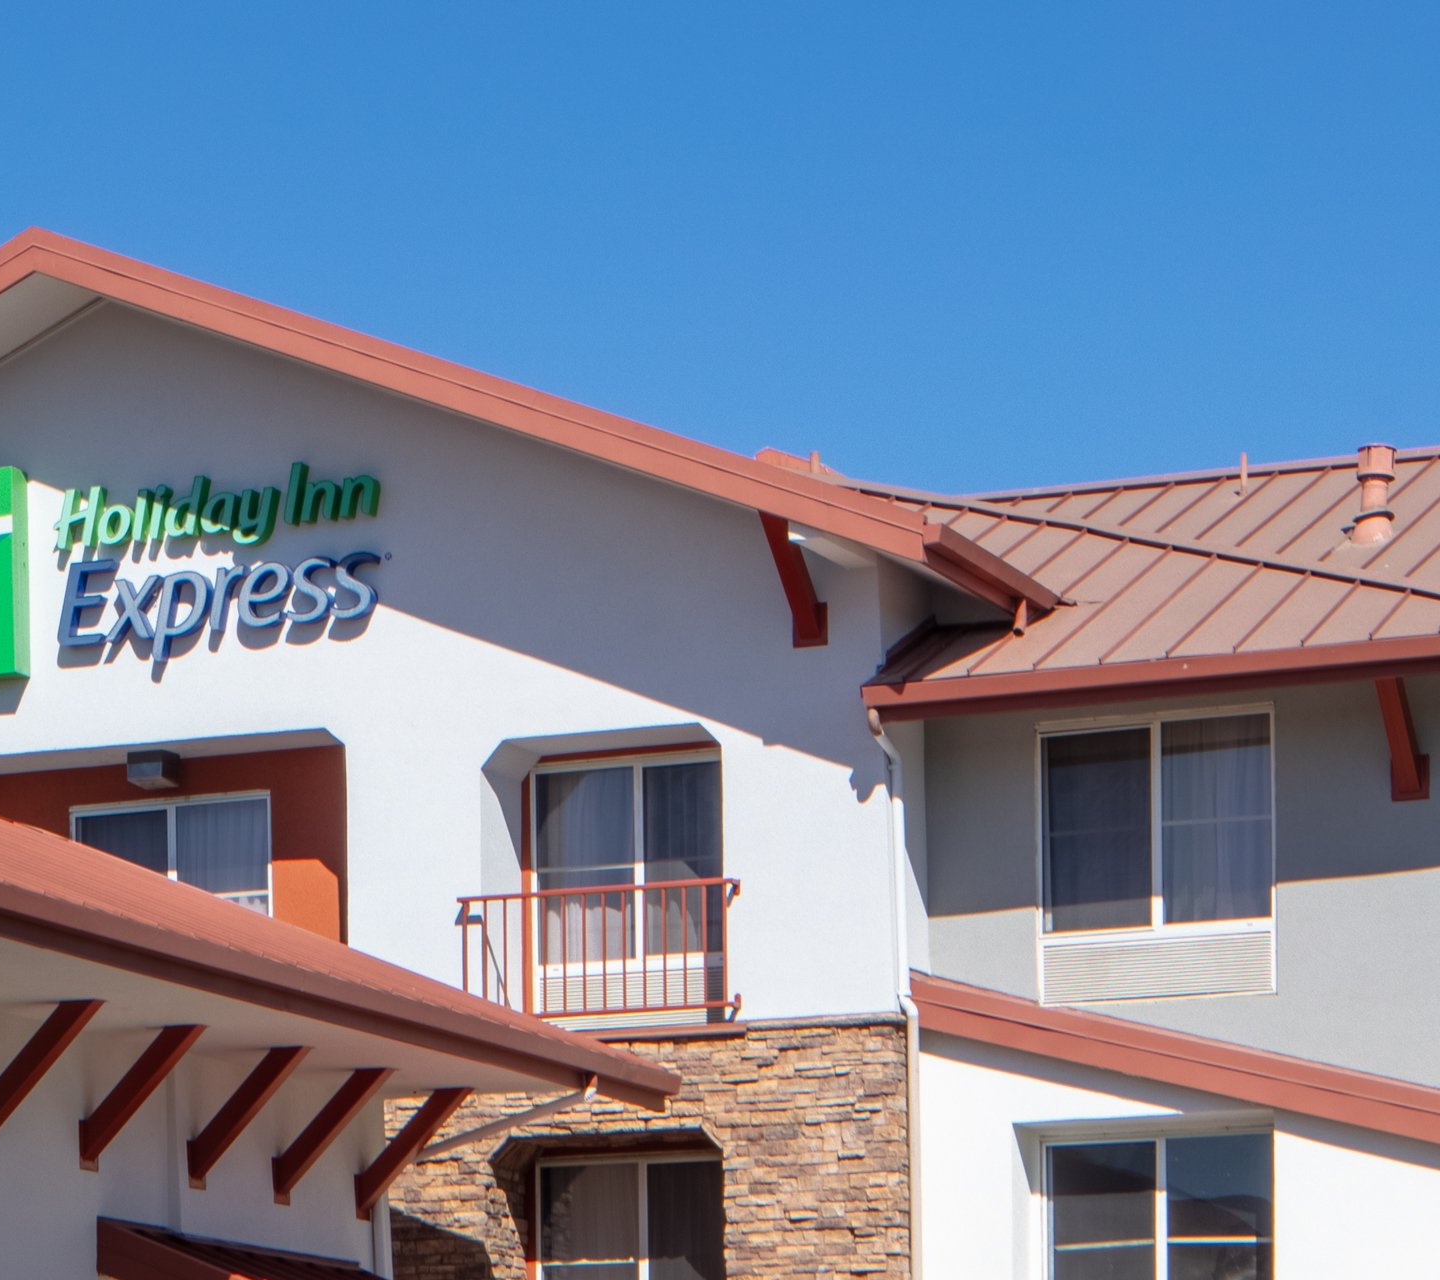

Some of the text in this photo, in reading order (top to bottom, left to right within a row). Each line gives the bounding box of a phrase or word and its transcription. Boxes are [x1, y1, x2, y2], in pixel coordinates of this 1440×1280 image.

[53, 461, 381, 551] Holiday Inn
[57, 551, 382, 662] Express
